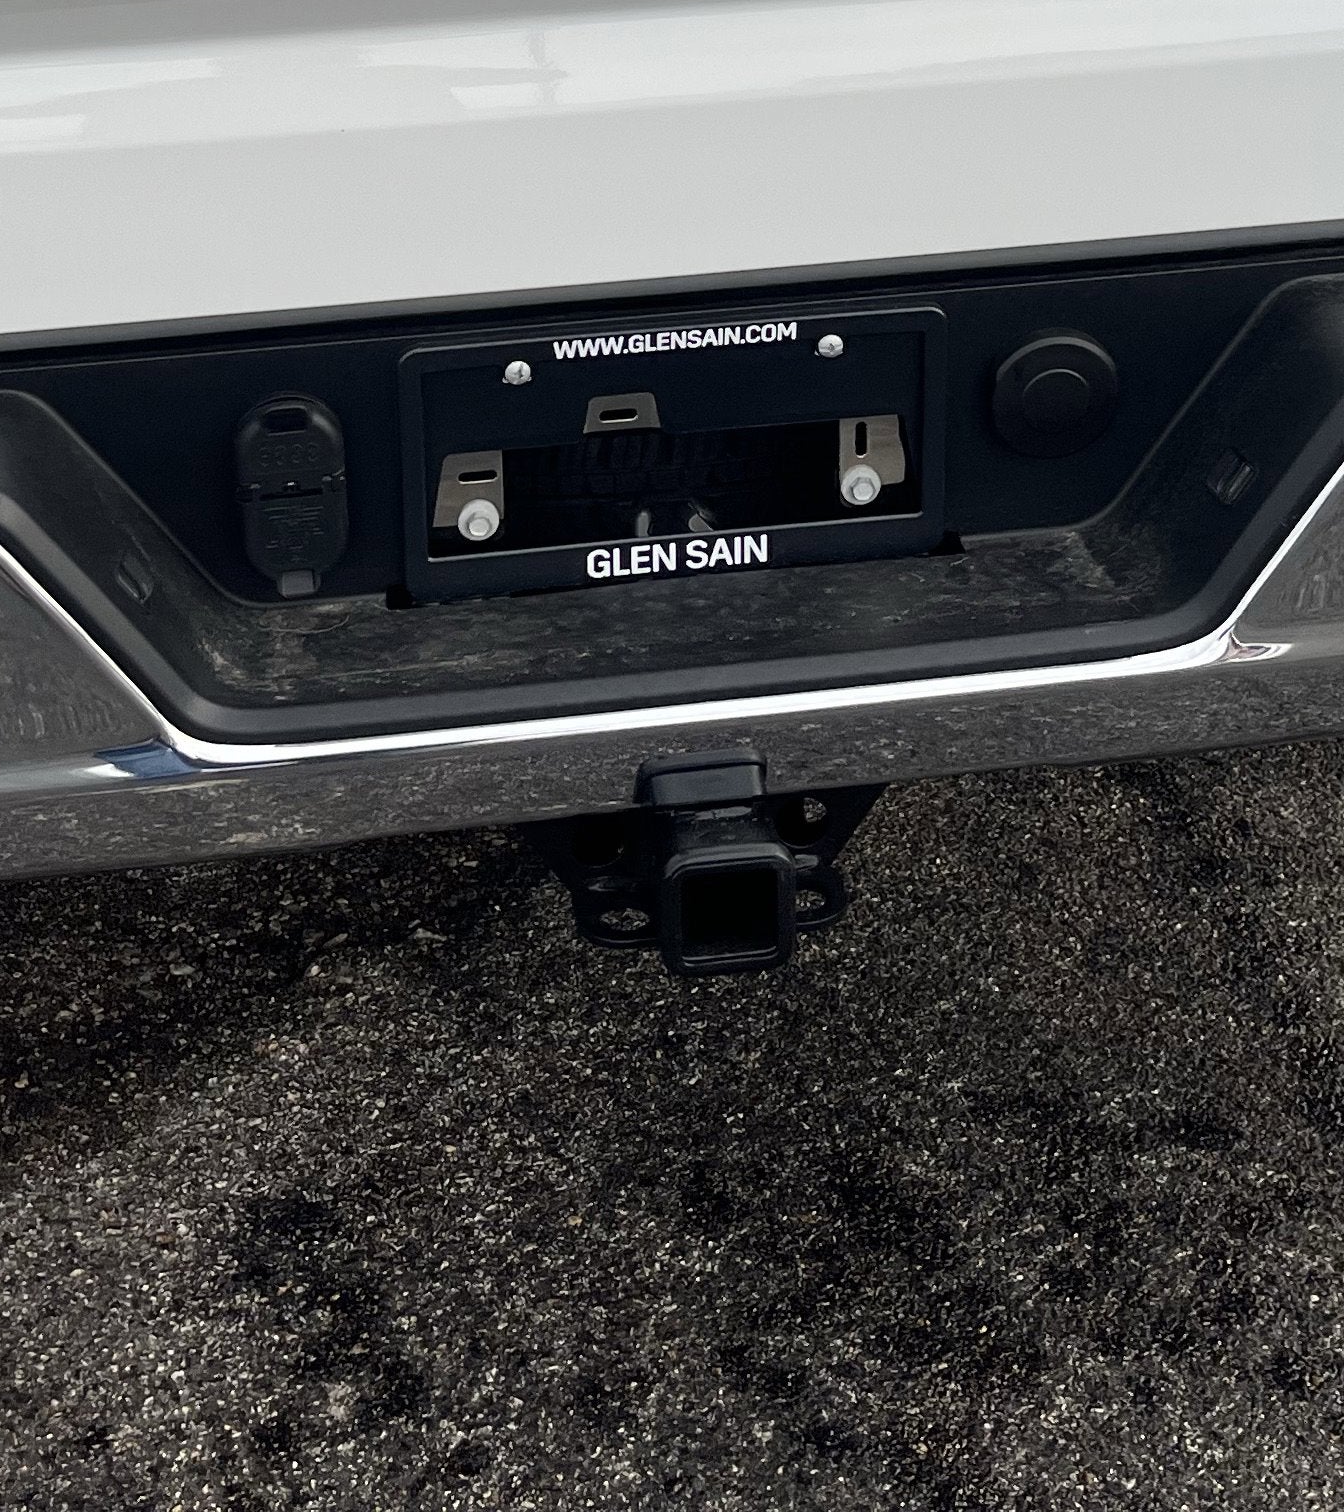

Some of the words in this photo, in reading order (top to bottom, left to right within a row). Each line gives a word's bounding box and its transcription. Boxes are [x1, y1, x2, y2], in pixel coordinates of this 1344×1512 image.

[553, 322, 798, 360] WWW.GLENSAIN.COM
[586, 542, 677, 579] GLEN
[686, 534, 768, 570] SAIN
